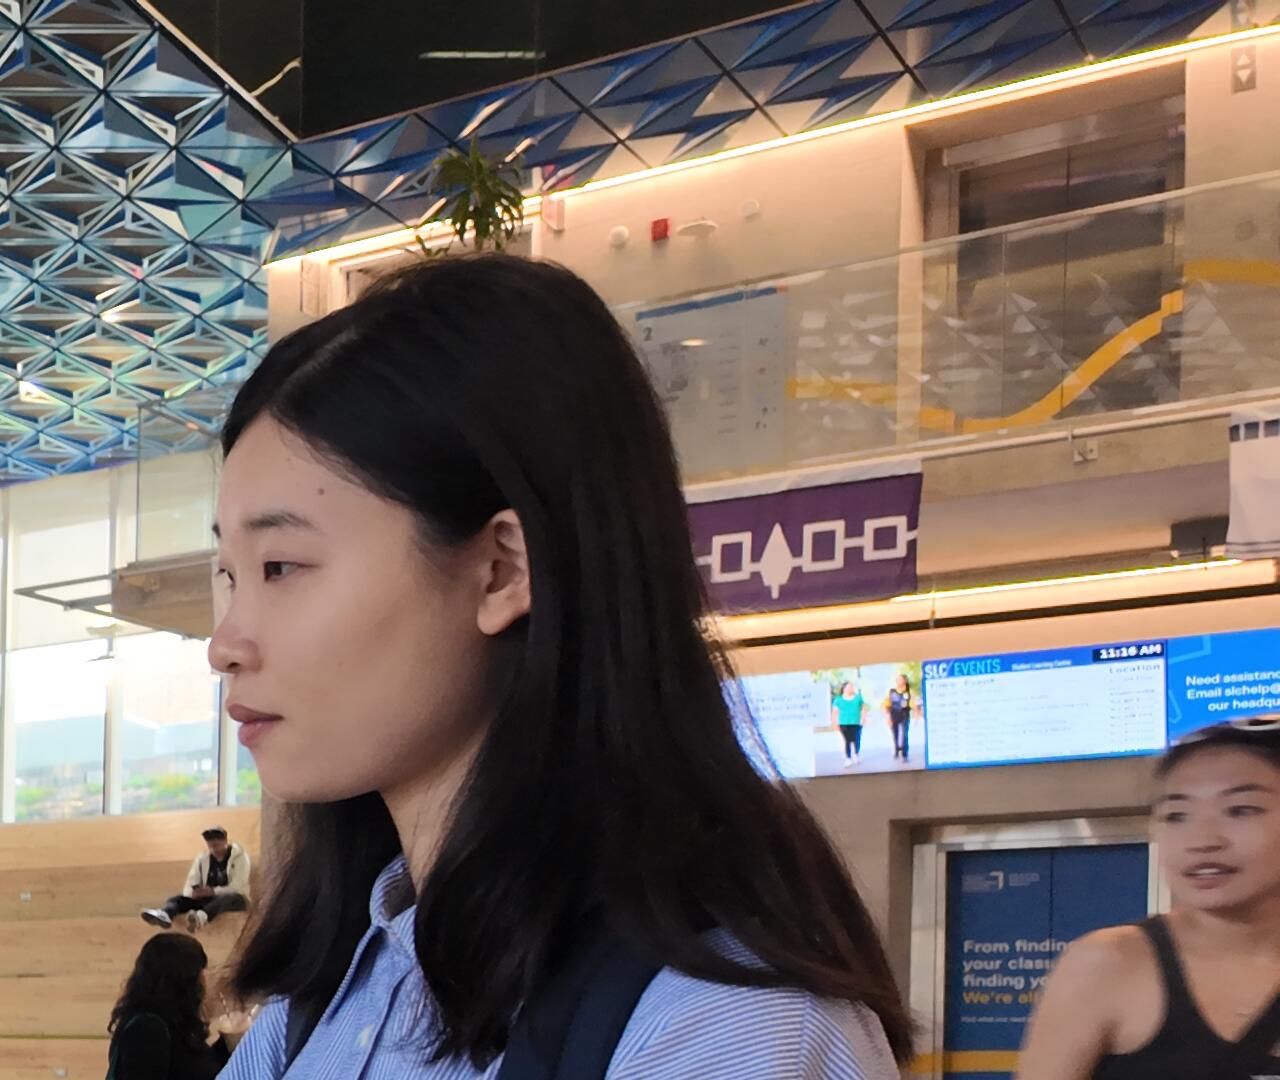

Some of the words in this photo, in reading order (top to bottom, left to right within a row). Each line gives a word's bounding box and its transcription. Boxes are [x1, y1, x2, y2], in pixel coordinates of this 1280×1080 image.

[1099, 645, 1138, 660] 11:16
[1138, 643, 1162, 656] AM
[1185, 673, 1220, 687] Need
[1186, 687, 1222, 700] Email
[1207, 701, 1230, 712] our
[963, 940, 1010, 954] From
[1014, 938, 1074, 954] findin
[963, 957, 1002, 973] your
[963, 974, 1025, 991] finding
[962, 990, 1013, 1005] We're
